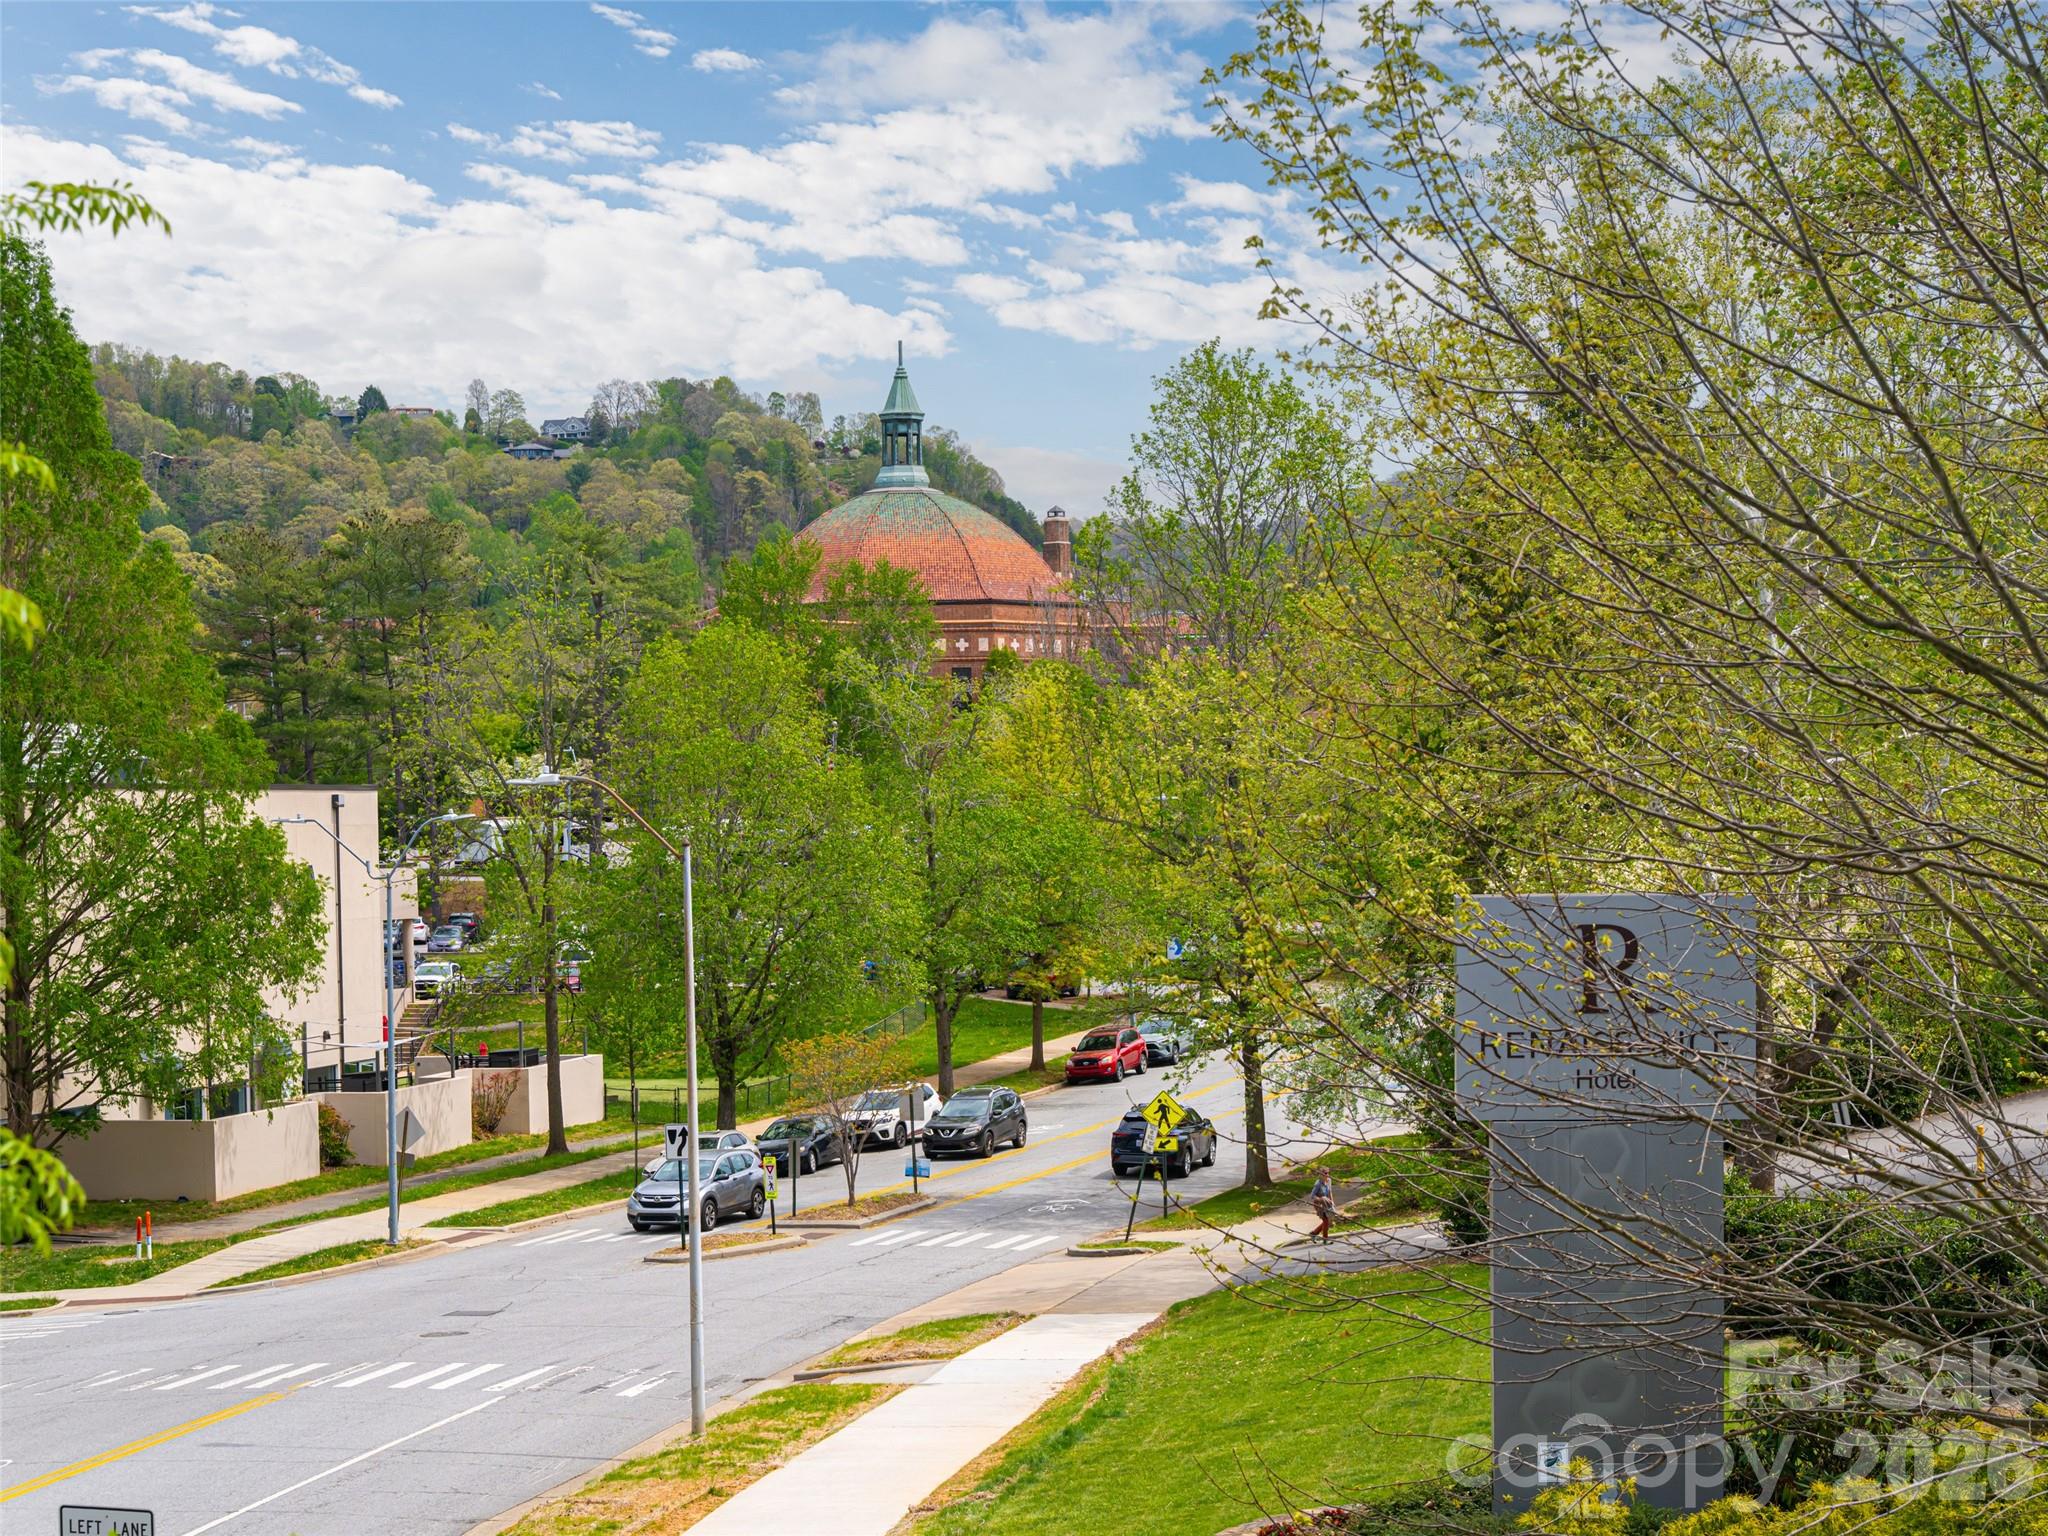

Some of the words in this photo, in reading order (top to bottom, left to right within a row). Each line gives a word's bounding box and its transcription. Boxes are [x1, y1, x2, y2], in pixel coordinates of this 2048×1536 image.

[1575, 923, 1666, 1014] R
[1576, 1069, 1636, 1090] Hotel
[69, 1519, 101, 1534] LEFT
[113, 1521, 148, 1536] LANE
